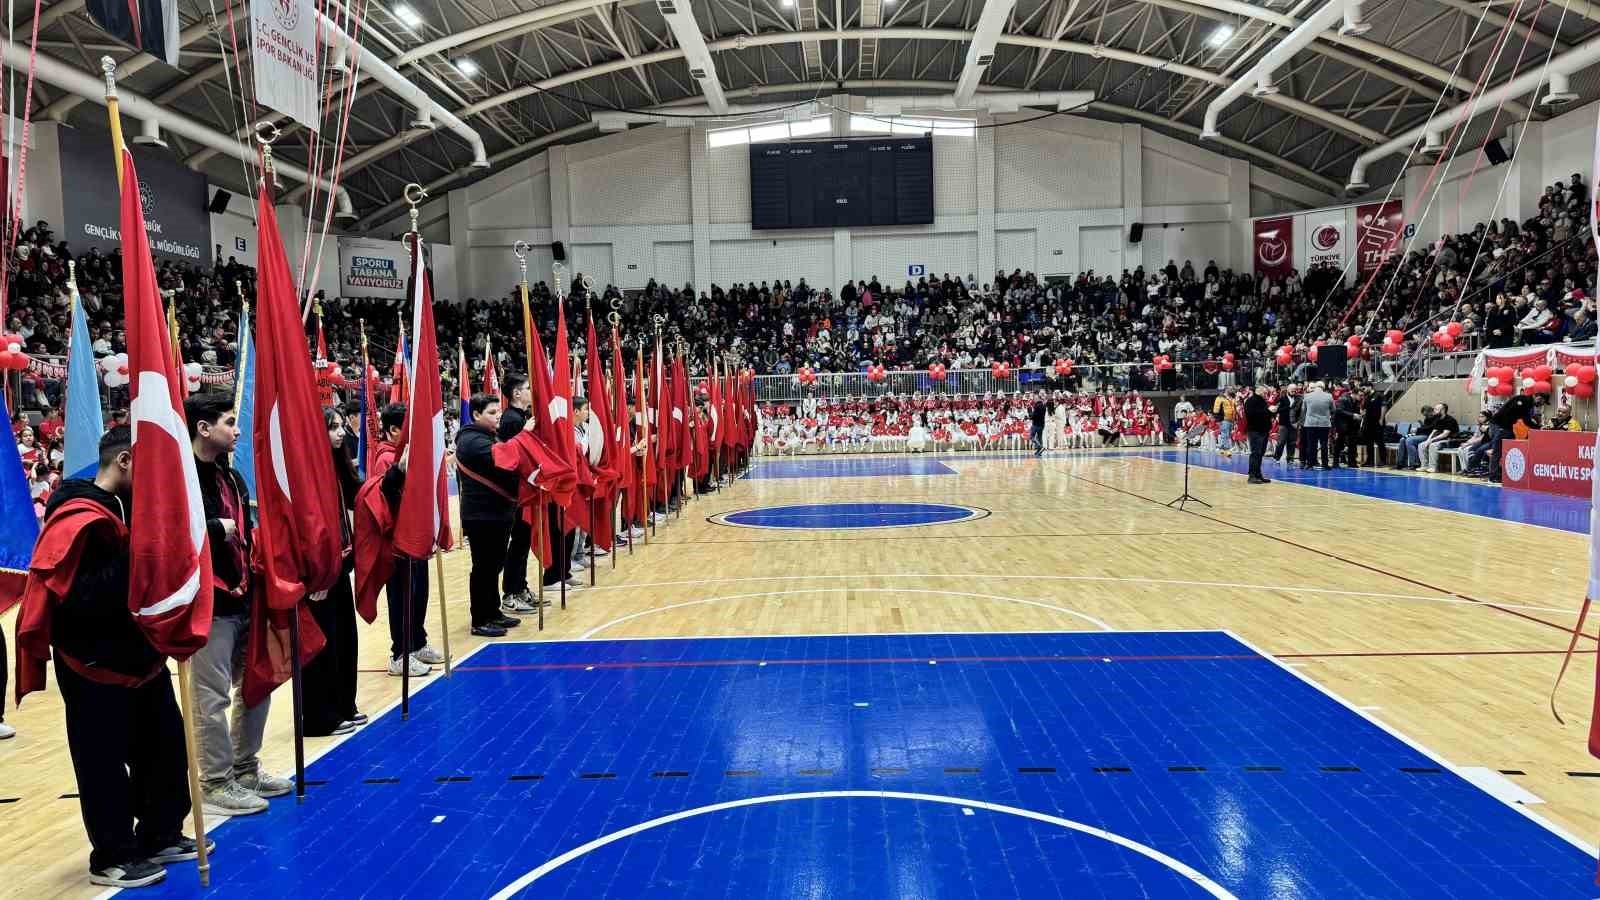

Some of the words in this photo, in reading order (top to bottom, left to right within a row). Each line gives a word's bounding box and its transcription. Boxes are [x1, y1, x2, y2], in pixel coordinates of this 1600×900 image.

[84, 223, 119, 241] GENÇLİK
[157, 240, 200, 259] MÜDÜRLÜĞÜ
[356, 258, 389, 269] SPORU
[354, 268, 393, 278] TABANA
[349, 276, 402, 289] YAYIYORUZ
[1533, 461, 1567, 481] GENÇLİK
[1568, 466, 1579, 480] VE
